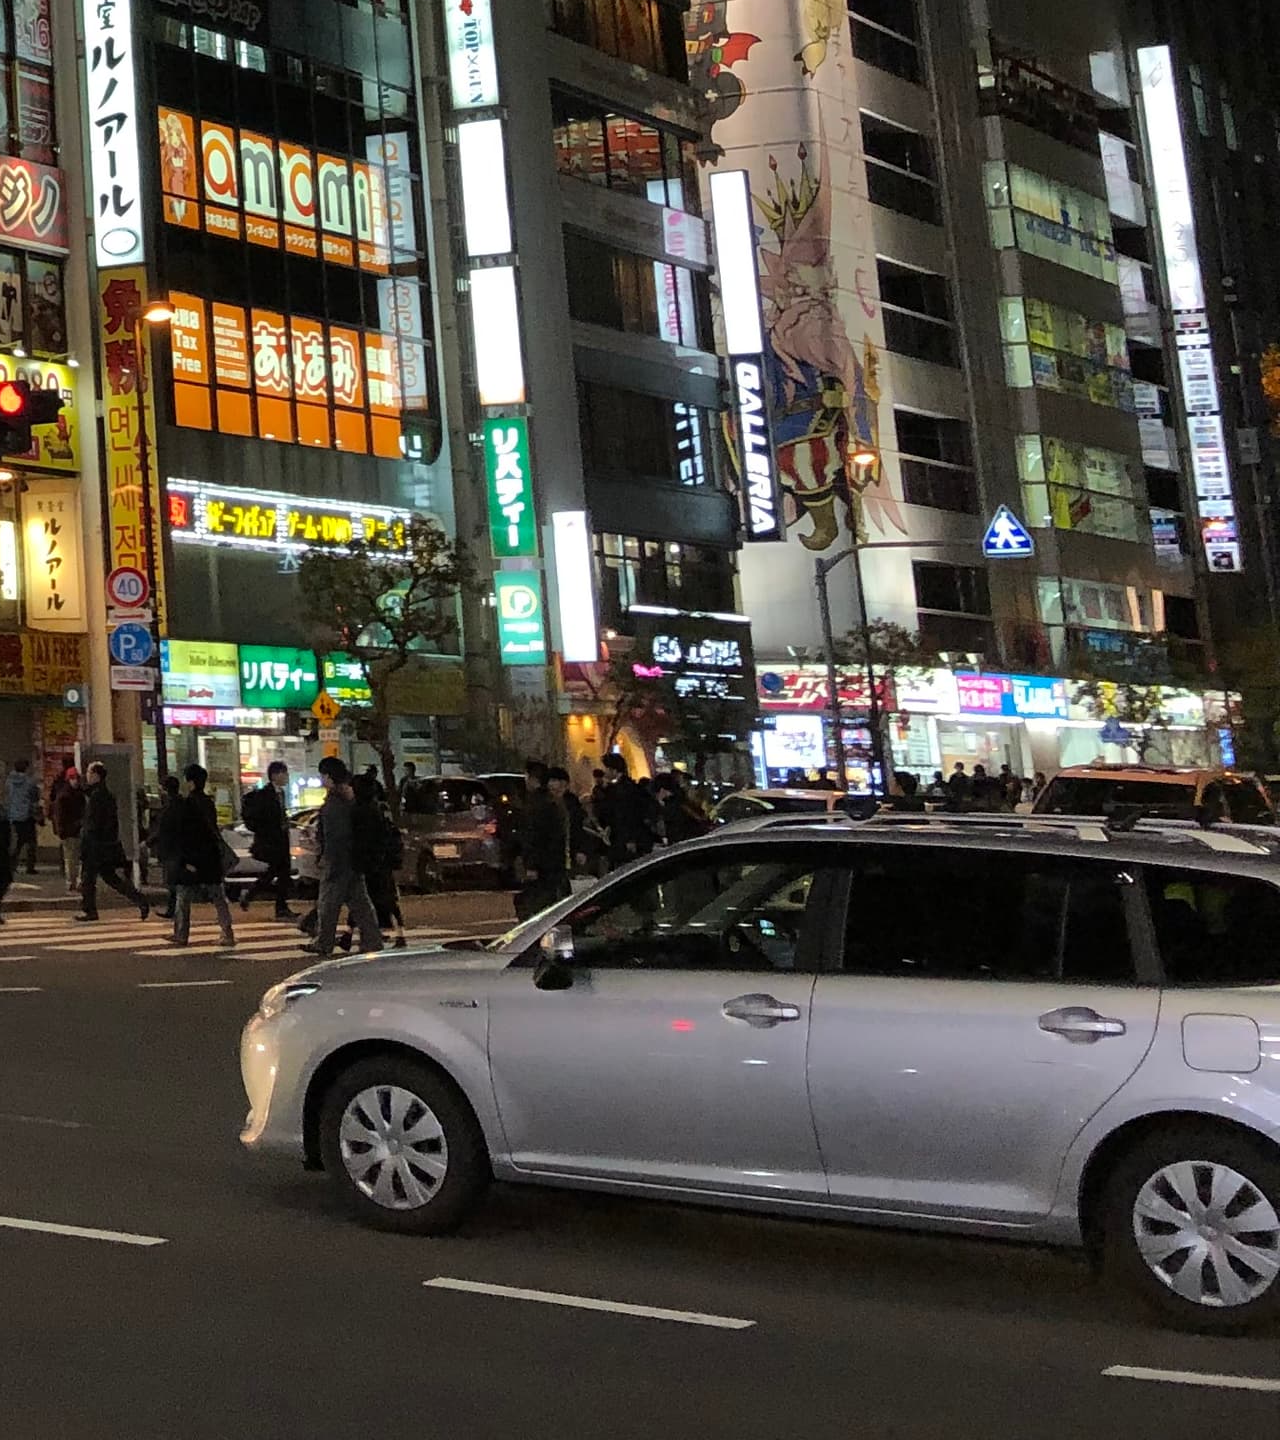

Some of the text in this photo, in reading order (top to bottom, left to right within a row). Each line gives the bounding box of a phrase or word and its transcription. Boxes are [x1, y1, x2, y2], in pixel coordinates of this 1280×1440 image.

[90, 35, 135, 220] ルノアール
[101, 278, 149, 397] 免税
[173, 329, 198, 351] Tax
[172, 351, 202, 374] Free
[736, 361, 778, 535] GALLERIA
[43, 517, 66, 612] ルノアール
[117, 578, 140, 596] 40
[119, 633, 137, 660] P
[242, 661, 316, 691] リバティー
